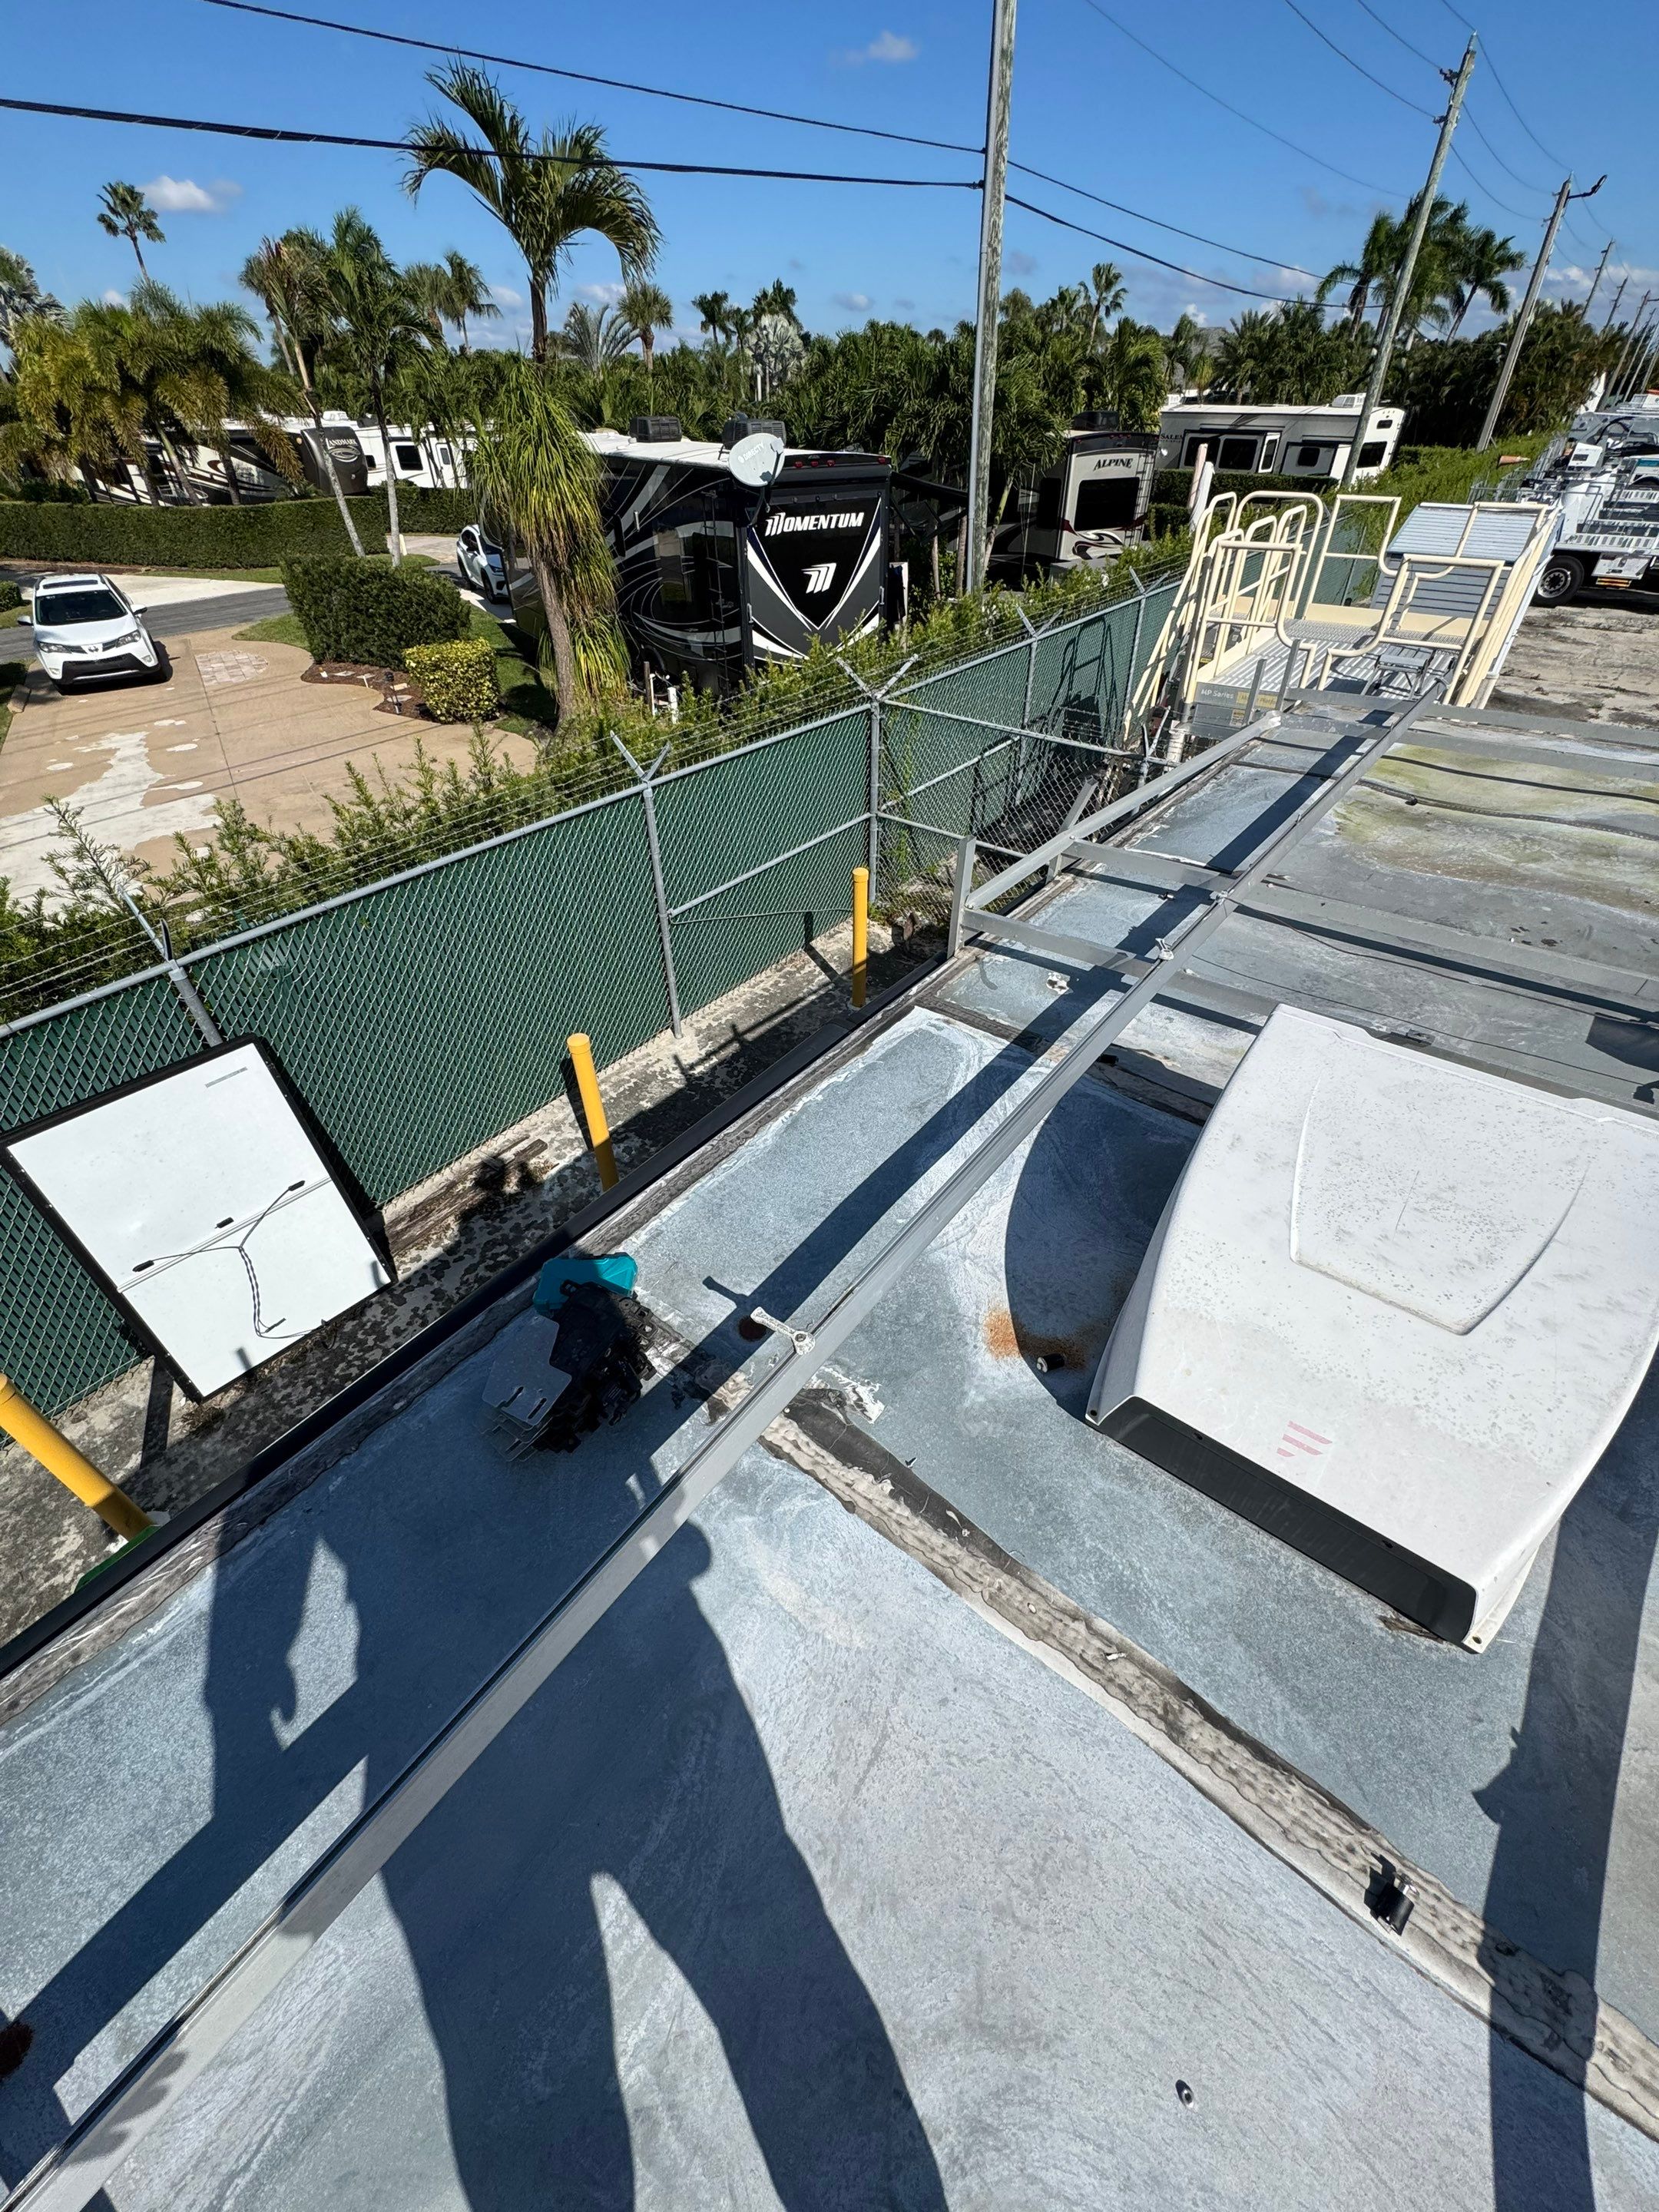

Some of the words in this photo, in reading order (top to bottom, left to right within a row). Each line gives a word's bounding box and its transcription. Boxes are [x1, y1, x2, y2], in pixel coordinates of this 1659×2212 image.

[326, 438, 358, 449] LANDMARK
[1093, 458, 1134, 471] ALPINE
[765, 512, 865, 536] MOMENTUM
